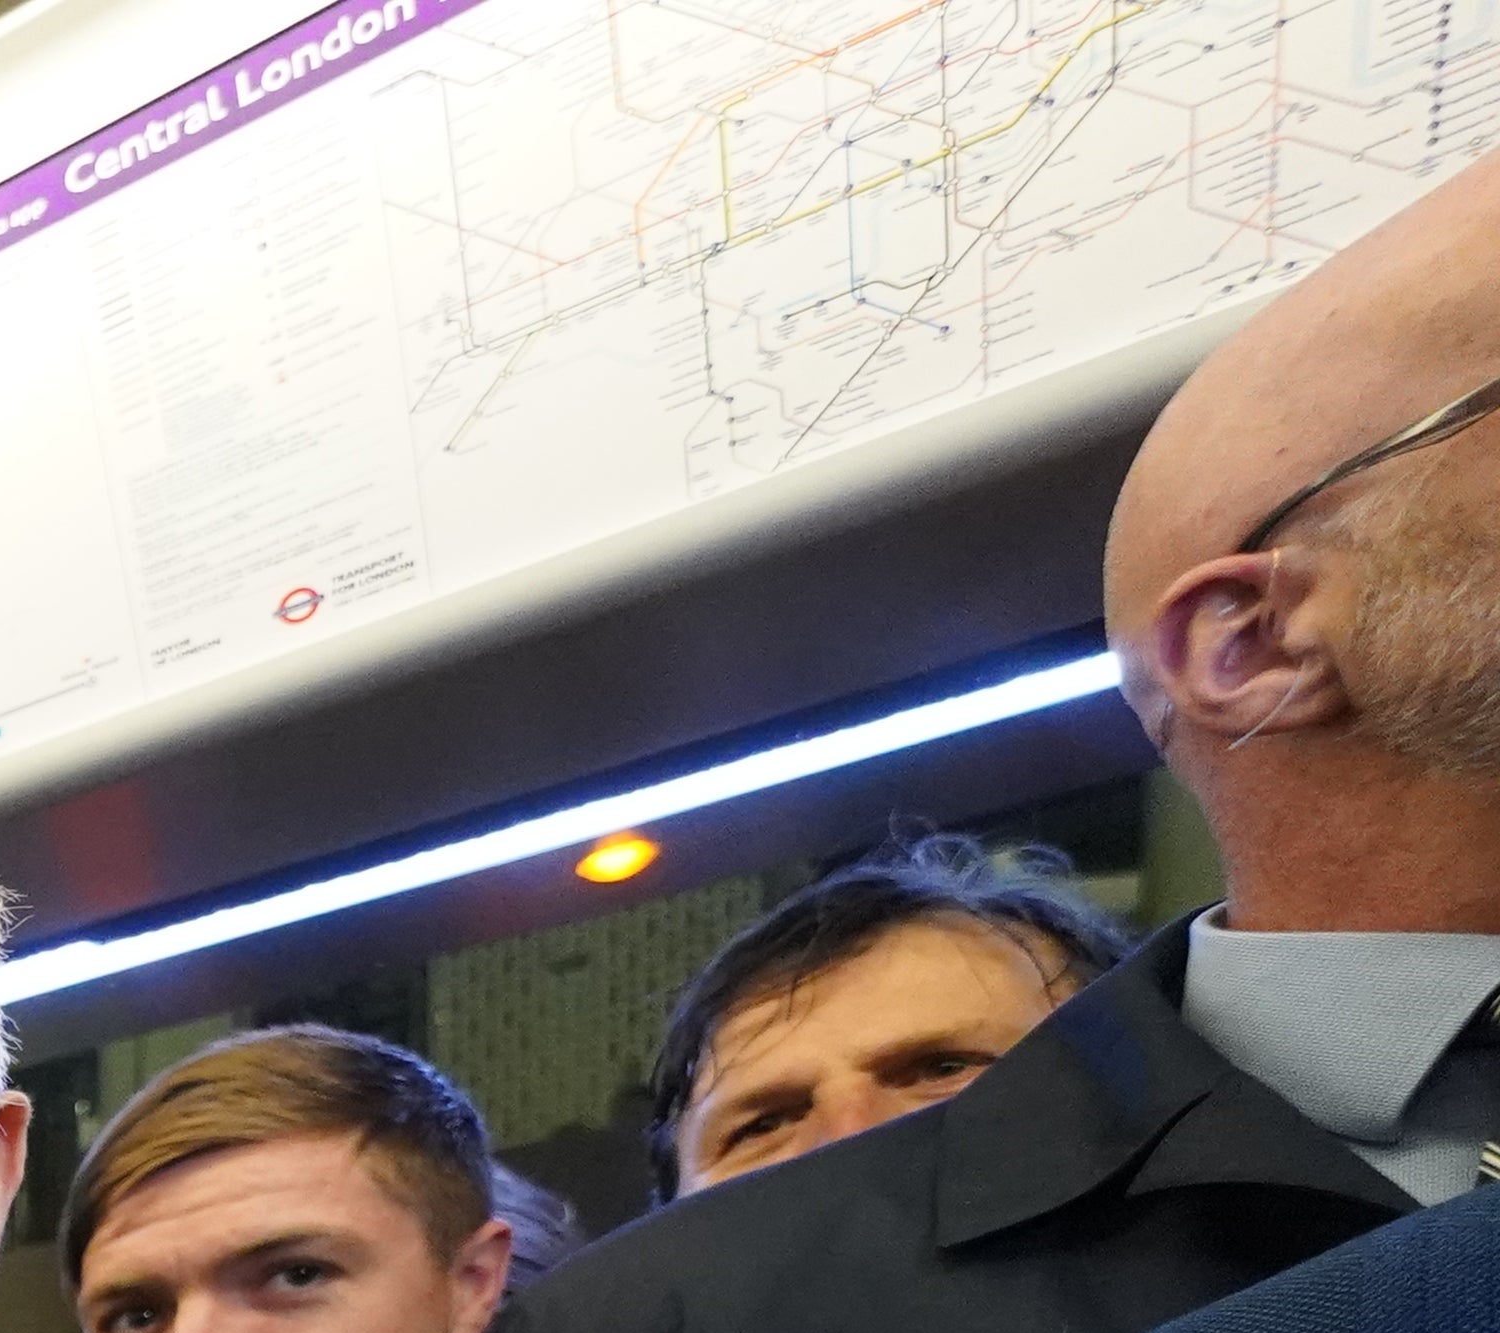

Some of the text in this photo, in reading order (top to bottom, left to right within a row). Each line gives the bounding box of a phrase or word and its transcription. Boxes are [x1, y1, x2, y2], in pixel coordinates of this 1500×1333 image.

[64, 0, 417, 194] Central London
[331, 551, 405, 585] TRANSPORT
[357, 559, 415, 588] LONDON
